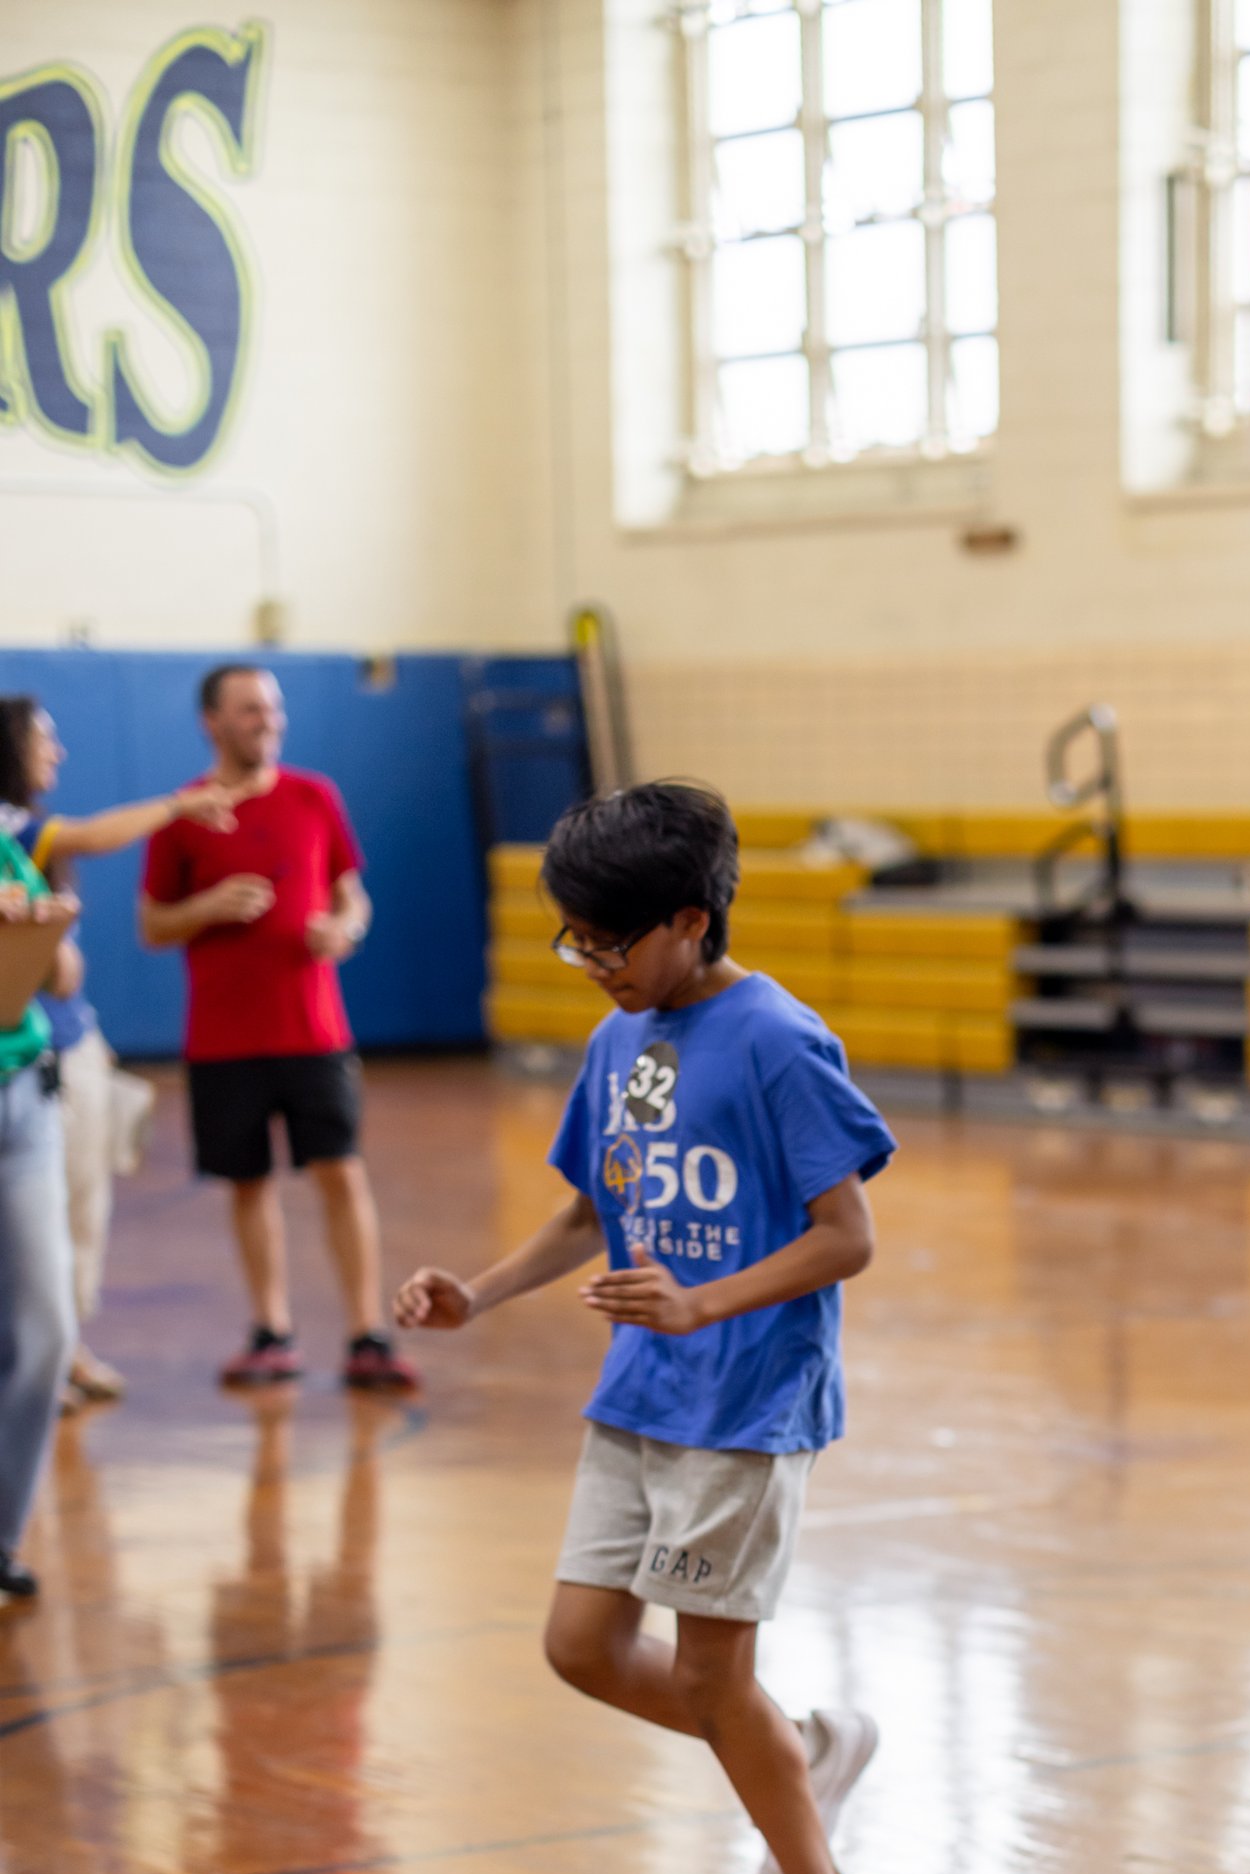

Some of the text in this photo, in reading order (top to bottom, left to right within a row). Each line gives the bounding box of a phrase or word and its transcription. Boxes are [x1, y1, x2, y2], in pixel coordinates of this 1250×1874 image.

[627, 1053, 676, 1111] 32
[643, 1141, 738, 1212] 50
[687, 1221, 740, 1245] THE
[650, 1545, 713, 1584] GAP
